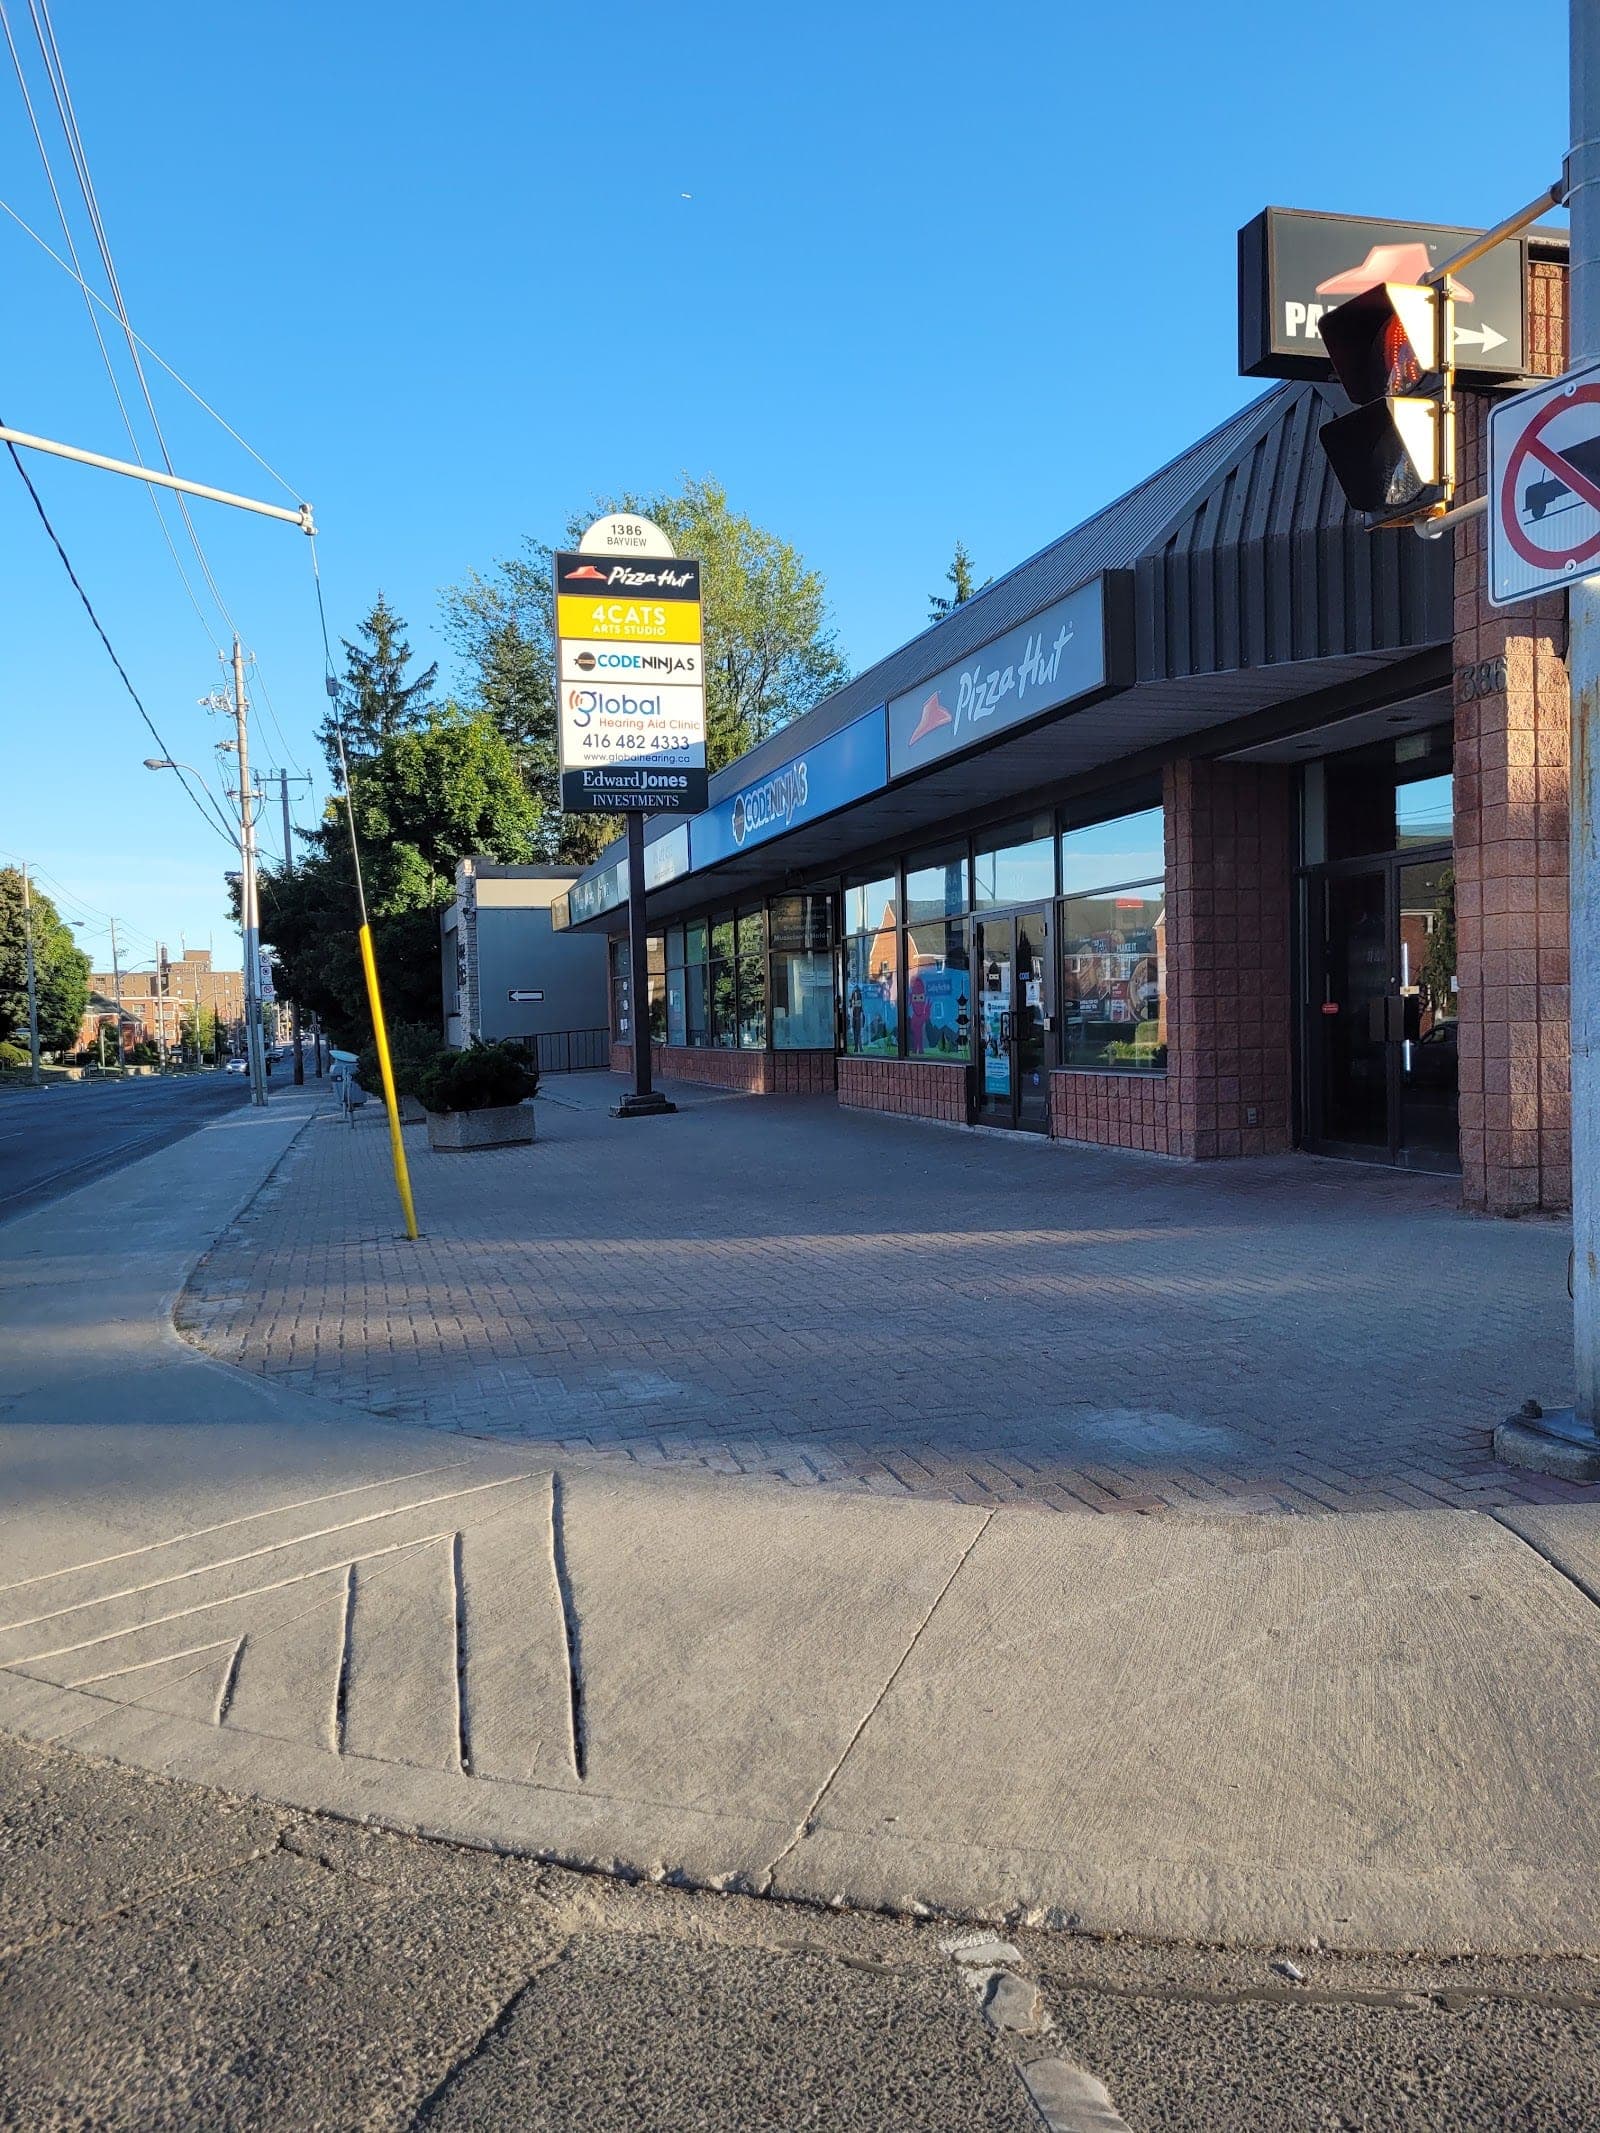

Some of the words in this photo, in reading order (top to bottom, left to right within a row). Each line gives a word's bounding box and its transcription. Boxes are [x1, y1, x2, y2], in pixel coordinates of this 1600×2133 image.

[1285, 301, 1338, 339] PA
[610, 524, 642, 536] 1386
[607, 537, 647, 547] BAYVIEW
[608, 566, 657, 585] Pizza
[657, 569, 693, 587] Hut
[592, 605, 666, 625] 4CATS
[593, 625, 621, 634] ARTS
[624, 625, 666, 636] STUDIO
[953, 664, 1014, 736] Pizza
[1018, 625, 1072, 698] Hut
[599, 717, 644, 731] Hearing
[648, 719, 666, 729] Aid
[669, 719, 700, 730] Clinic
[583, 734, 611, 748] 416
[616, 735, 646, 749] 482
[651, 736, 689, 750] 4333
[584, 753, 690, 763] www.globalhearing.ca
[593, 794, 679, 807] INVESTMENTS
